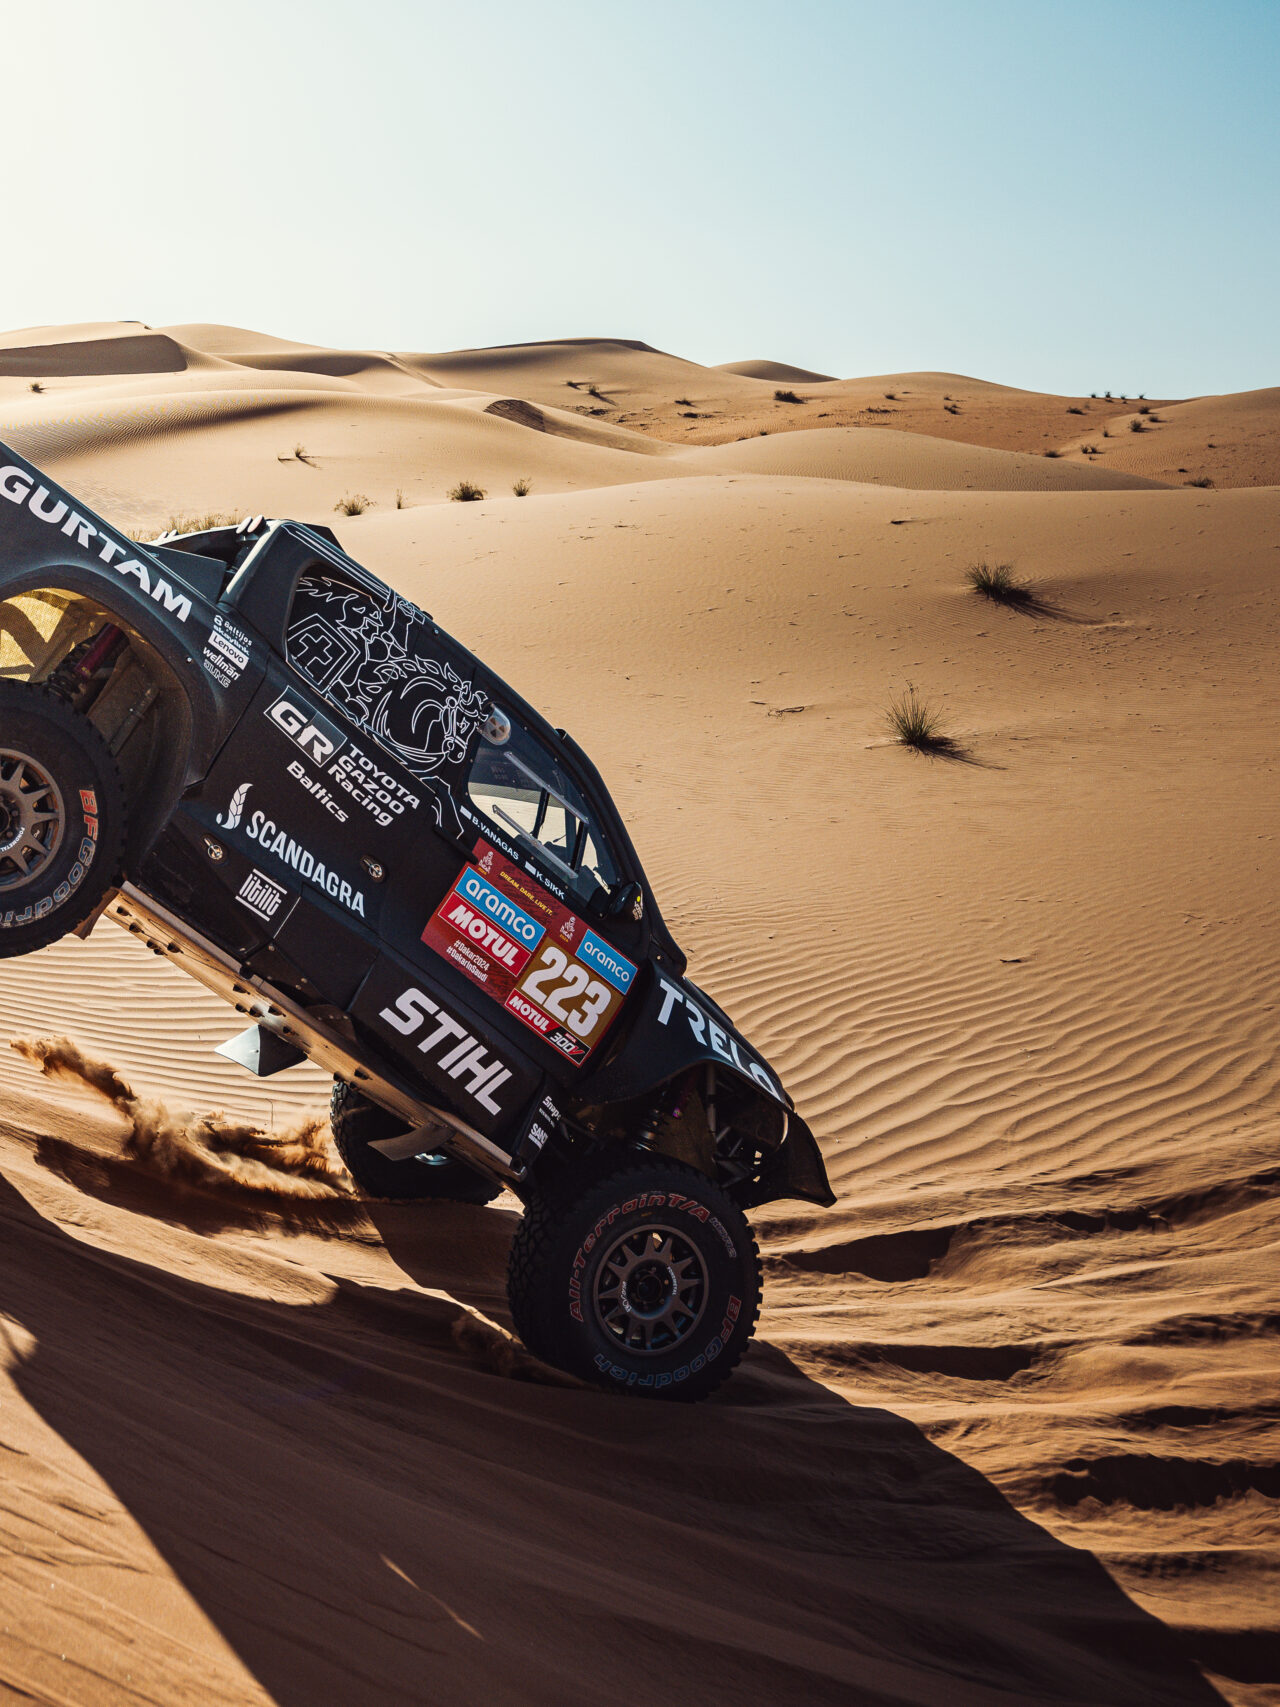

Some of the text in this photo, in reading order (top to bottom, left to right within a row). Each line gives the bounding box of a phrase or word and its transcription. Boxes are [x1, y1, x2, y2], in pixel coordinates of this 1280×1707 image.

[213, 635, 244, 663] Lenovo
[271, 701, 334, 763] GR
[286, 760, 349, 823] Baltics
[327, 764, 394, 827] Racing
[338, 755, 405, 815] GAZOO
[349, 743, 420, 810] TOYOTA
[245, 810, 366, 918] SCANDAGRA
[499, 871, 520, 889] DREAM.
[448, 904, 520, 967] MOTUL
[465, 878, 536, 941] aramco
[453, 939, 489, 972] #Dakar2024
[583, 941, 630, 982] aramco
[509, 995, 550, 1032] MOTUL
[520, 946, 612, 1038] 223
[378, 987, 513, 1116] STIHL
[549, 1032, 585, 1057] 300V
